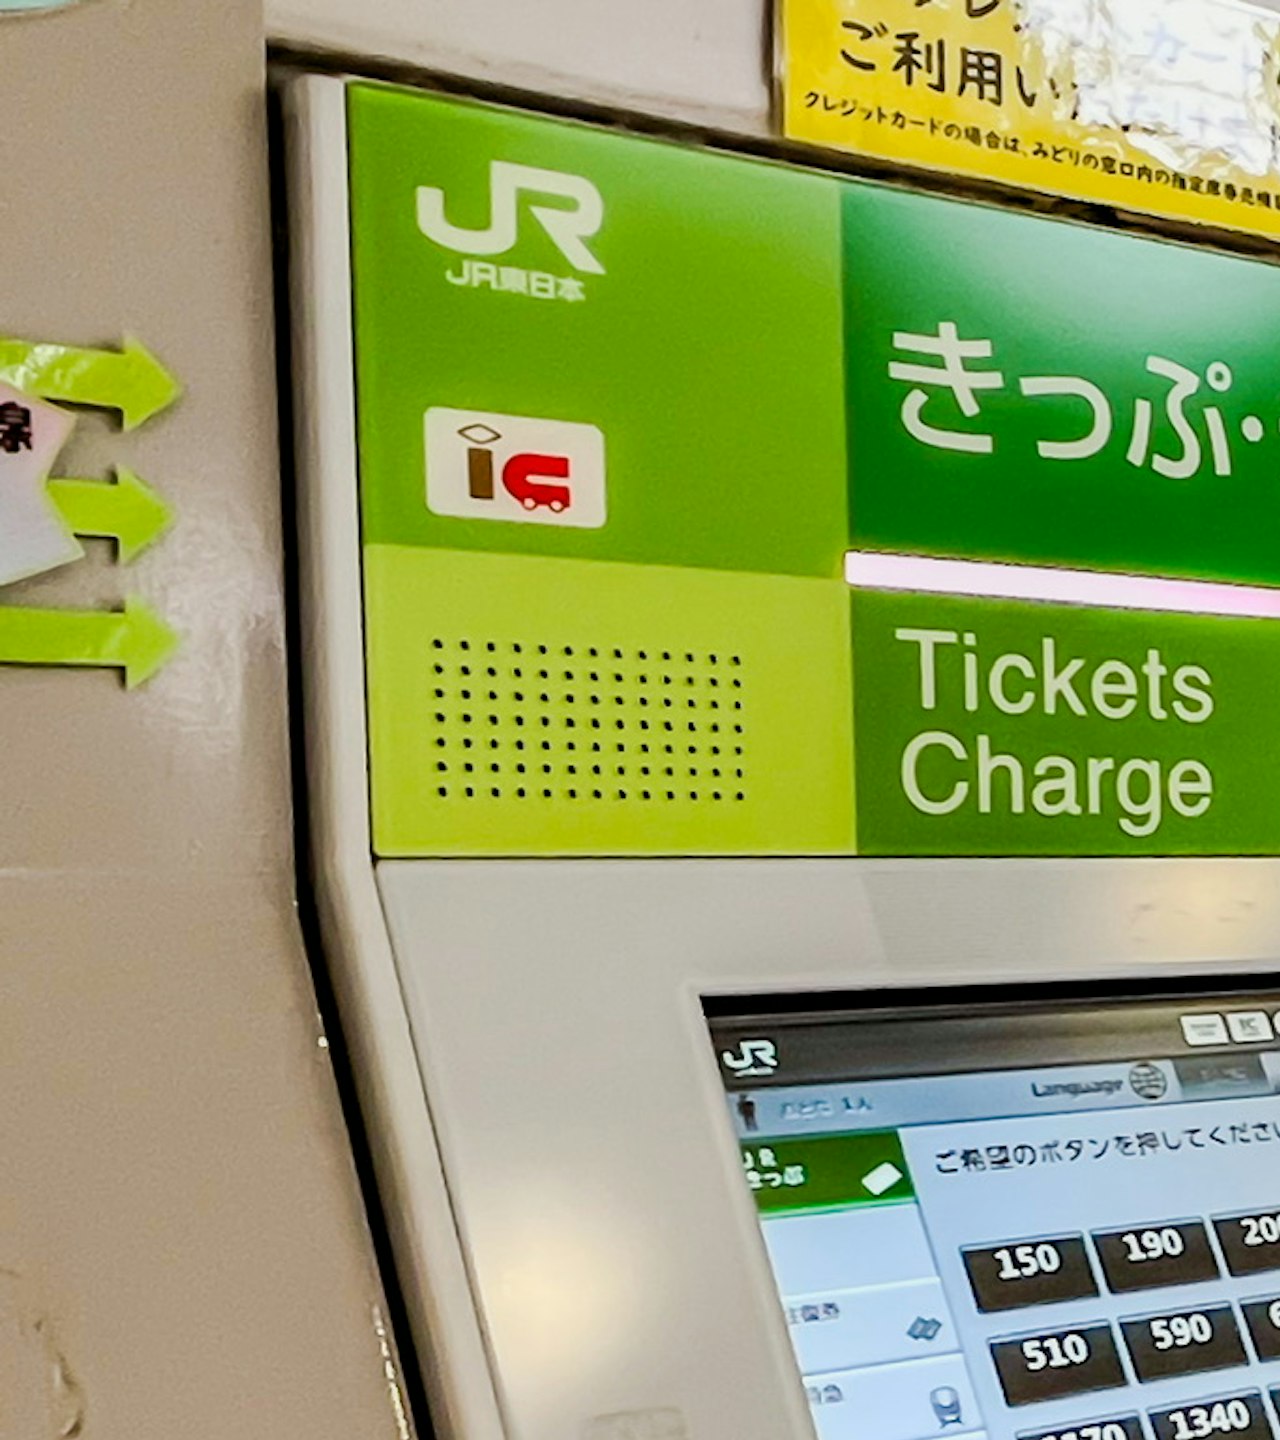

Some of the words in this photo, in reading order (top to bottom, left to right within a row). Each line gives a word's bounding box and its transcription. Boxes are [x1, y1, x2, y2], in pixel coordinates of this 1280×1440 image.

[416, 160, 606, 274] JR
[445, 259, 586, 302] JR東日本
[895, 628, 1215, 724] Tickets
[901, 731, 1213, 837] Charge
[723, 1039, 778, 1070] JR
[1031, 1074, 1125, 1100] Language
[994, 1244, 1061, 1280] 150
[1122, 1228, 1184, 1263] 190
[1022, 1333, 1089, 1371] 510
[1150, 1316, 1213, 1351] 590
